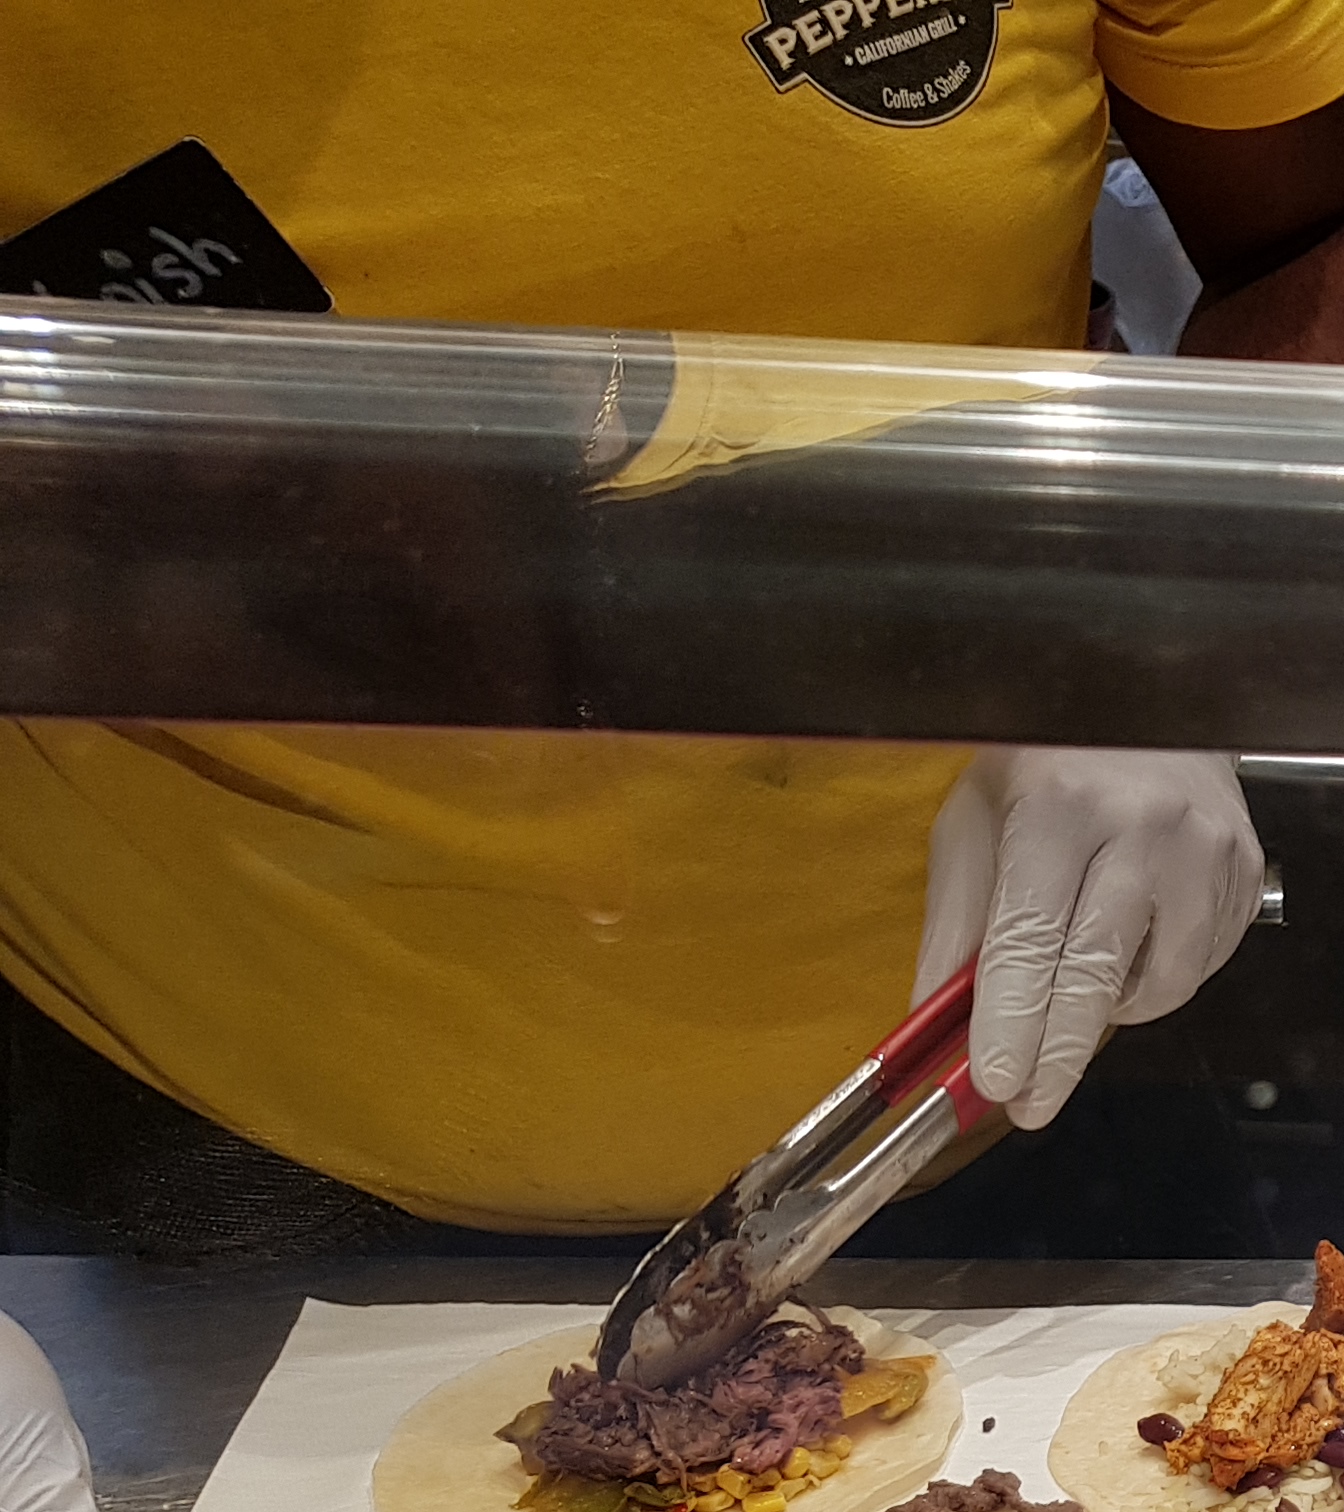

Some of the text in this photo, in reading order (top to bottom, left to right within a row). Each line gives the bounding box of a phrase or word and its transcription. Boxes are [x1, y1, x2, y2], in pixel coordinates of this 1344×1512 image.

[854, 14, 958, 66] CALIFORNIAN GRILL
[882, 60, 971, 109] Coffee & Shakes
